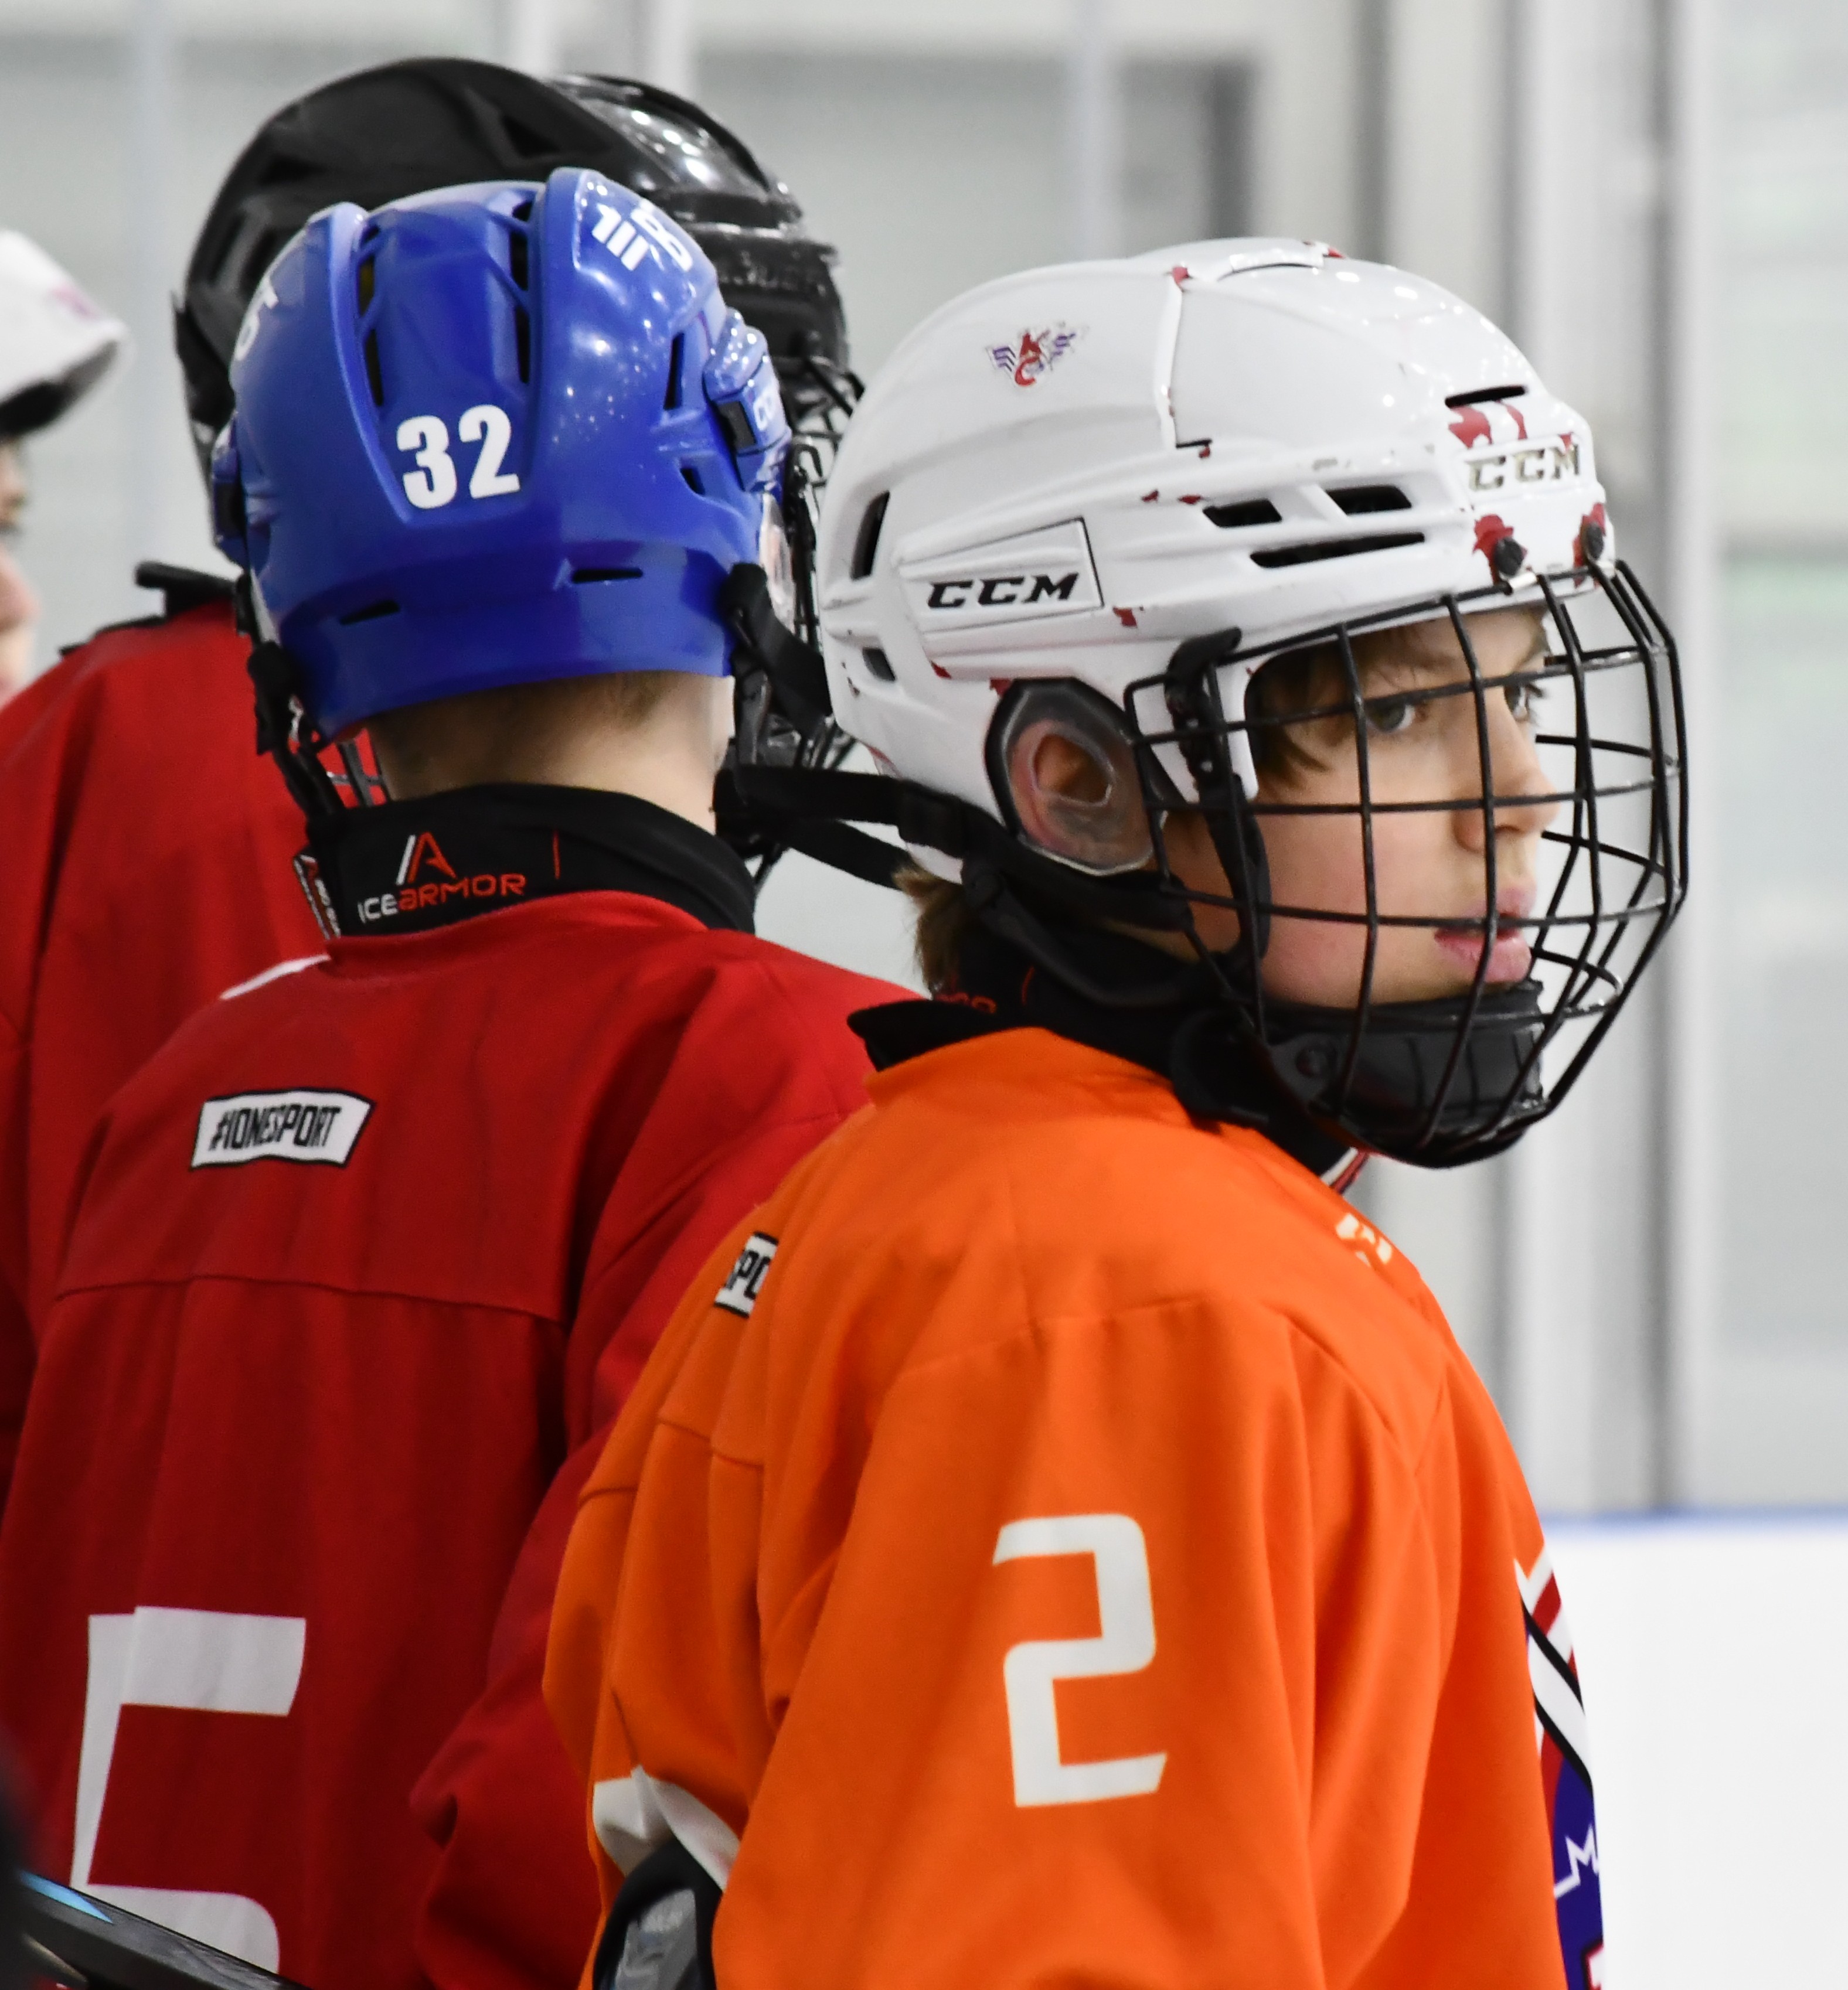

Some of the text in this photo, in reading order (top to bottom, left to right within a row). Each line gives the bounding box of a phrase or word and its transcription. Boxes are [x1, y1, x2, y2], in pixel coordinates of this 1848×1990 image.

[397, 406, 520, 509] 32
[1465, 444, 1580, 492] CCM
[927, 571, 1079, 608] CCM
[992, 1514, 1167, 1807] 2
[70, 1606, 305, 1975] 5
